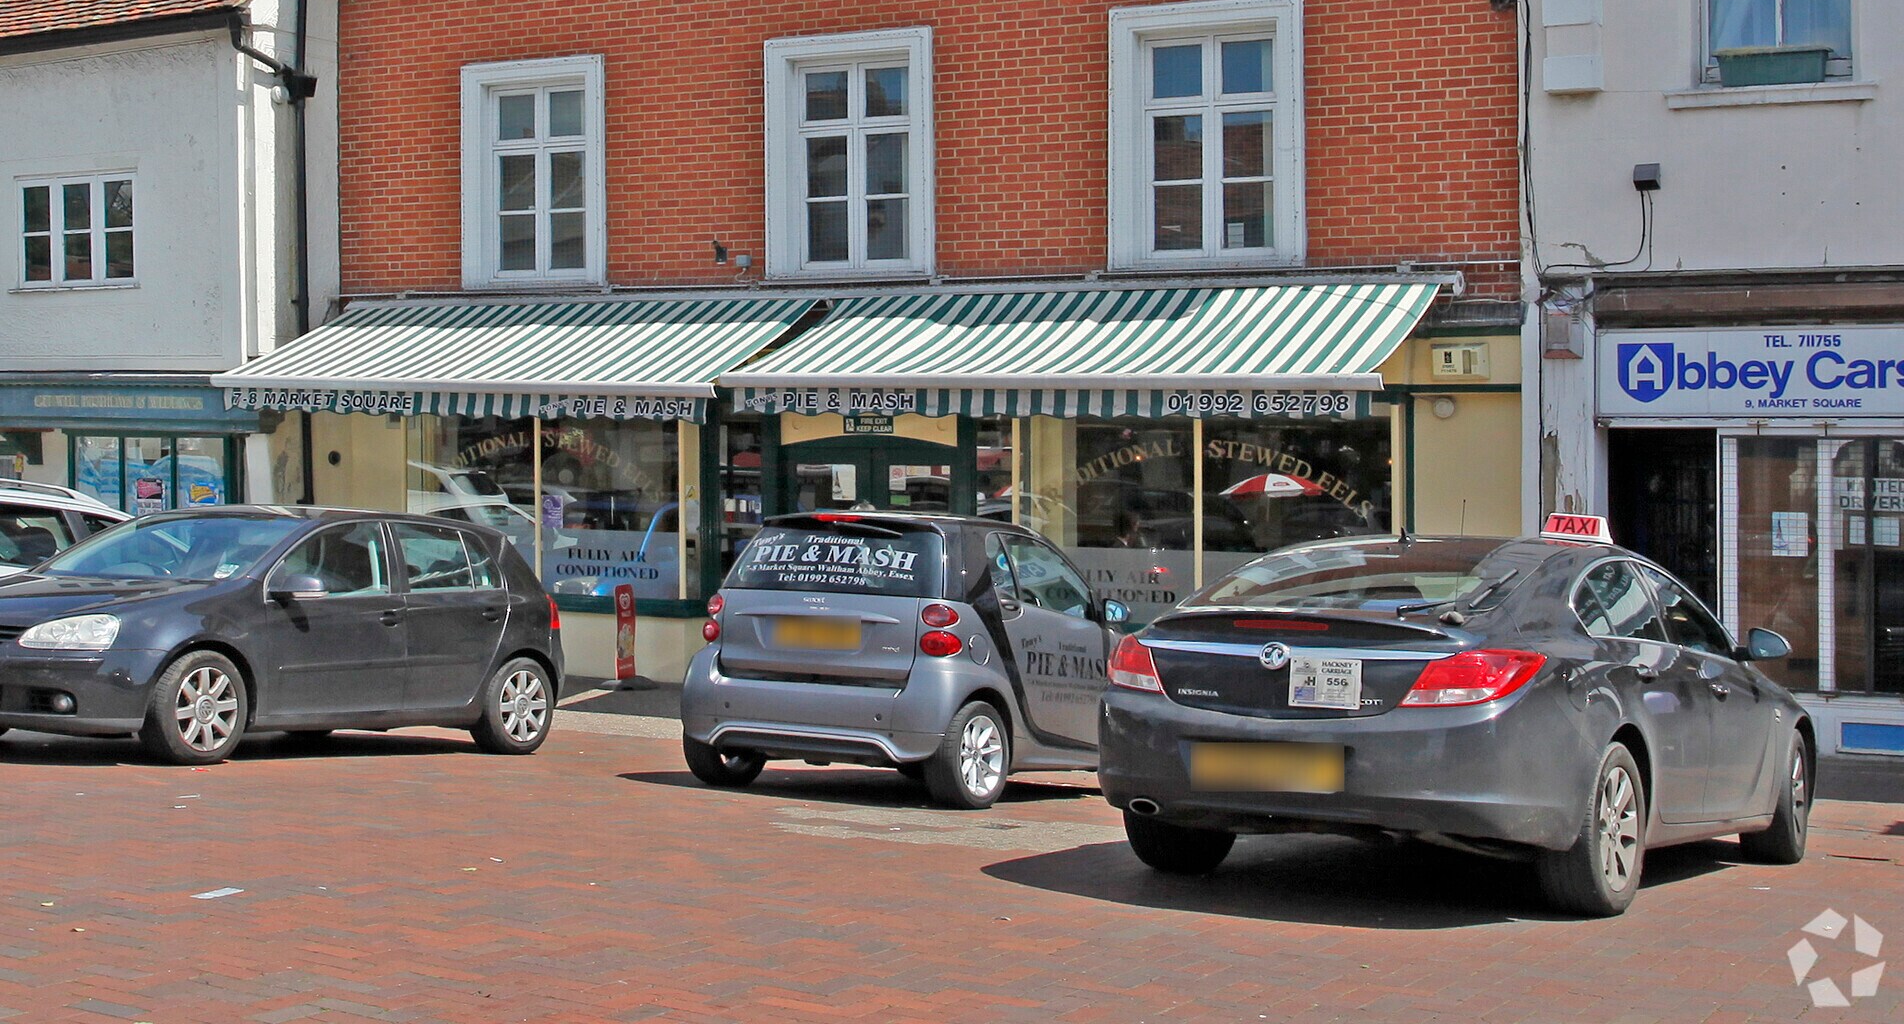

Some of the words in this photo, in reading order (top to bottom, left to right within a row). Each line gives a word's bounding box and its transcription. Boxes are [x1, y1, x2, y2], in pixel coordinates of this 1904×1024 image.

[1764, 335, 1792, 348] TEL.
[1798, 334, 1841, 348] 711755
[1628, 343, 1795, 398] Abbey
[232, 391, 258, 405] 7-8
[263, 392, 335, 407] MARKET
[340, 394, 413, 410] SQUARE
[572, 398, 606, 415] PIE
[613, 399, 627, 415] &
[634, 400, 693, 416] MASH
[782, 392, 818, 409] PIE
[826, 392, 841, 409] &
[851, 392, 915, 410] MASH
[1168, 393, 1244, 412] 01992
[1253, 394, 1350, 413] 652798
[1744, 399, 1755, 409] 9,
[1757, 398, 1808, 408] MARKET
[1812, 398, 1862, 408] SQUARE
[860, 417, 874, 425] FIRE
[875, 417, 888, 425] EXIT
[1208, 438, 1313, 479] STEWED
[1316, 470, 1375, 519] EELS
[1552, 517, 1598, 535] TAXI
[753, 532, 786, 548] Tony's
[805, 534, 865, 545] Traditional
[568, 548, 613, 560] FULLY
[621, 550, 647, 563] AIR
[753, 544, 800, 563] PIE
[801, 544, 822, 563] &
[825, 544, 919, 571] MASH
[556, 563, 660, 580] CONDITIONED
[758, 563, 786, 571] Market
[786, 564, 816, 573] Square
[817, 564, 855, 574] Waltham
[888, 570, 915, 582] Essex
[779, 573, 796, 582] Tel:
[798, 573, 827, 583] 01992
[828, 574, 866, 586] 652798
[1026, 651, 1055, 676] PIE
[1058, 654, 1068, 677] &
[1072, 656, 1108, 680] MAS
[1321, 660, 1354, 669] HACKNEY
[1321, 667, 1353, 676] CARRIAGE
[1326, 678, 1348, 687] 556
[1177, 688, 1220, 698] INSIGNIA
